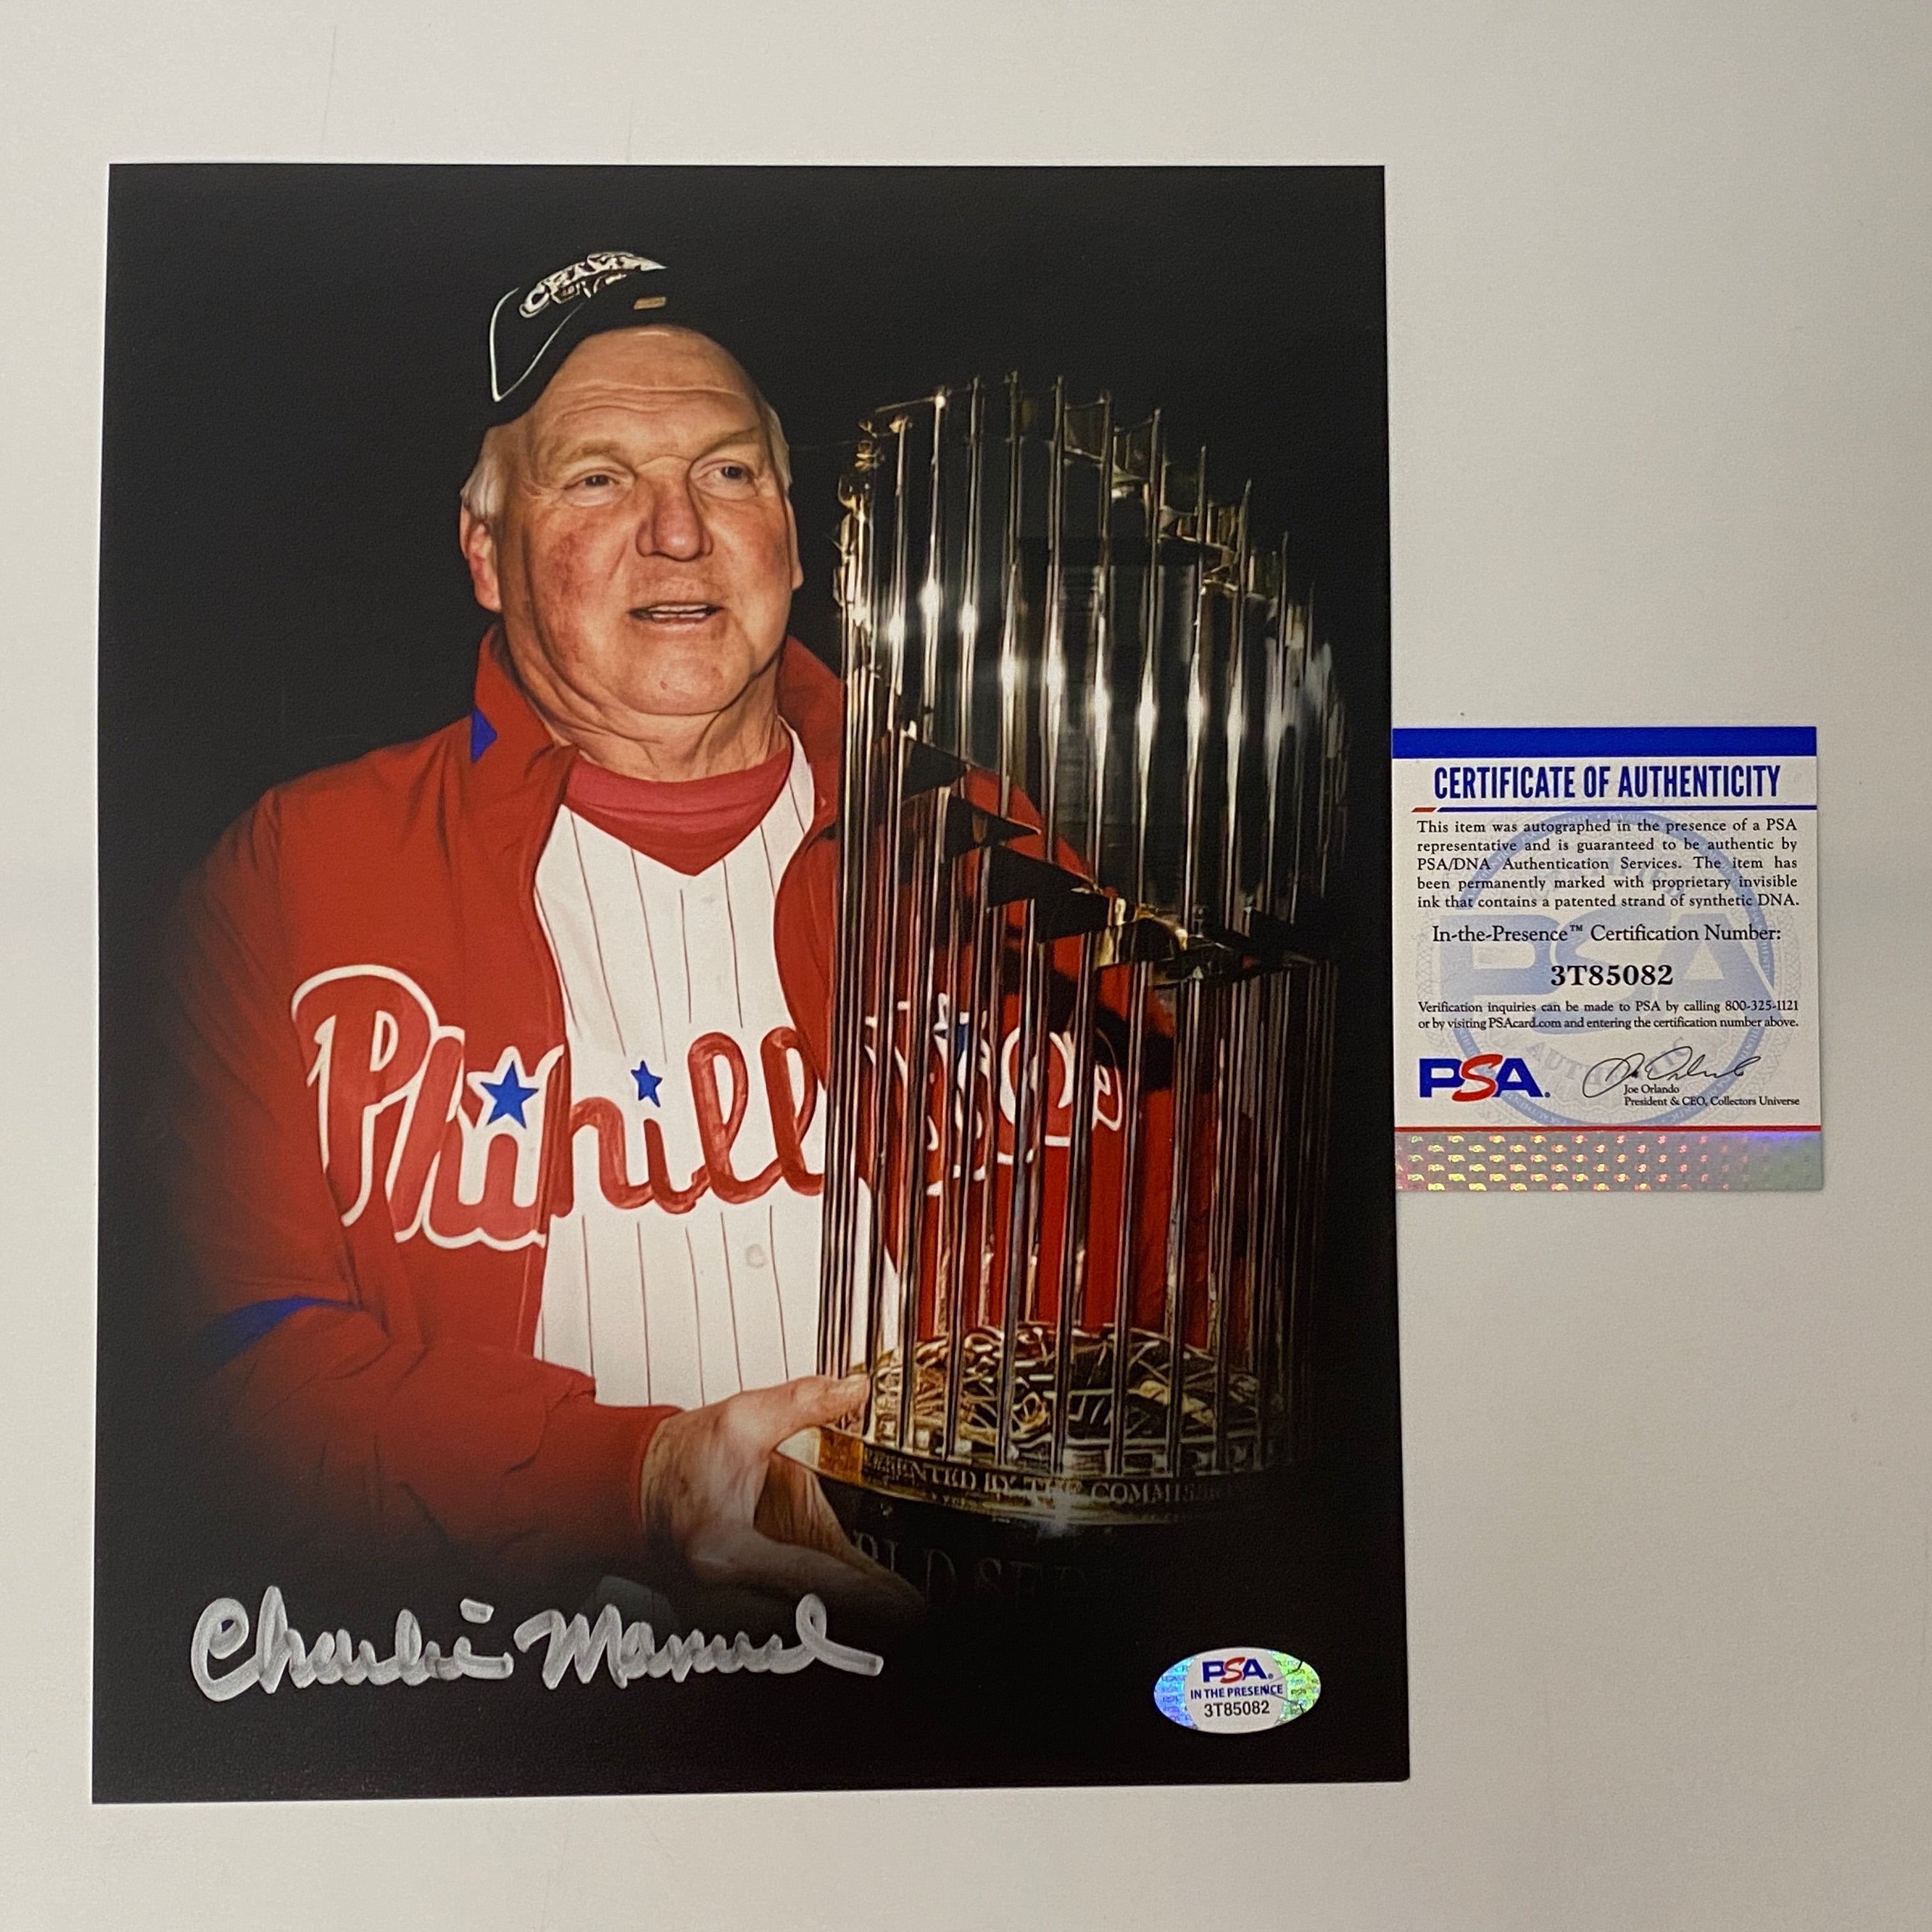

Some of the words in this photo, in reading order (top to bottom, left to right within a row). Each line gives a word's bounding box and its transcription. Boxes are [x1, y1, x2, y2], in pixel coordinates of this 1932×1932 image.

[1434, 766, 1575, 799] CERTIFICATE
[1584, 765, 1611, 798] OF
[1618, 765, 1781, 798] AUTHENTICITY
[1416, 820, 1448, 833] This
[1455, 821, 1485, 832] item
[1492, 824, 1517, 832] was
[1523, 818, 1611, 835] autographed
[1617, 820, 1631, 832] in
[1637, 818, 1660, 832] the
[1665, 822, 1726, 834] presence
[1733, 817, 1748, 831] of
[1752, 822, 1760, 831] a
[1766, 818, 1797, 831] PSA
[1417, 839, 1517, 855] representative
[1524, 838, 1551, 851] and
[1558, 839, 1568, 851] is
[1577, 837, 1654, 854] guaranteed
[1662, 841, 1676, 850] to
[1683, 837, 1699, 850] be
[1707, 836, 1774, 850] authentic
[1781, 836, 1797, 852] by
[1417, 857, 1491, 871] PSA/DNA
[1502, 857, 1609, 870] Authentication
[1620, 856, 1682, 870] Services.
[1692, 855, 1721, 869] The
[1732, 857, 1763, 869] item
[1774, 855, 1797, 868] has
[1417, 876, 1450, 889] been
[1458, 875, 1545, 892] permanently
[1554, 875, 1606, 888] marked
[1613, 875, 1644, 888] with
[1652, 876, 1731, 891] proprietary
[1738, 874, 1798, 887] invisible
[1418, 895, 1440, 908] ink
[1445, 894, 1473, 908] that
[1478, 896, 1537, 908] contains
[1542, 899, 1549, 907] a
[1554, 894, 1616, 910] patented
[1621, 894, 1666, 907] strand
[1670, 893, 1685, 907] of
[1689, 893, 1753, 909] synthetic
[1758, 893, 1799, 906] DNA.
[1590, 923, 1699, 941] Certification
[1704, 923, 1781, 940] Number:
[1551, 964, 1673, 986] 3T85082
[1418, 1000, 1483, 1013] Verification
[1488, 1002, 1537, 1015] inquiries
[1565, 1000, 1579, 1012] be
[1584, 1000, 1614, 1012] made
[1619, 1004, 1630, 1012] to
[1635, 1000, 1661, 1011] PSA
[1666, 1000, 1679, 1013] by
[1683, 1000, 1721, 1013] calling
[1724, 1000, 1798, 1011] 800-325-1121
[1432, 1016, 1445, 1031] by
[1447, 1018, 1487, 1031] visiting
[1488, 1016, 1562, 1029] PSAcard.com
[1563, 1016, 1585, 1028] and
[1586, 1017, 1632, 1030] entering
[1634, 1016, 1651, 1028] the
[1653, 1016, 1717, 1028] certification
[1719, 1015, 1763, 1027] number
[1764, 1015, 1798, 1027] above.
[1419, 1053, 1544, 1102] PSA
[1623, 1084, 1639, 1096] Joe
[1641, 1084, 1680, 1094] Orlando
[1624, 1096, 1667, 1106] President
[1669, 1096, 1680, 1106] &
[1682, 1096, 1708, 1107] CEO,
[1710, 1095, 1757, 1106] Collectors
[1758, 1096, 1800, 1105] Universe
[1202, 1657, 1268, 1683] PSA
[1190, 1689, 1202, 1699] IN
[1204, 1687, 1225, 1699] THE
[1227, 1684, 1284, 1698] PRESENCE
[1204, 1700, 1270, 1718] 3T85082
